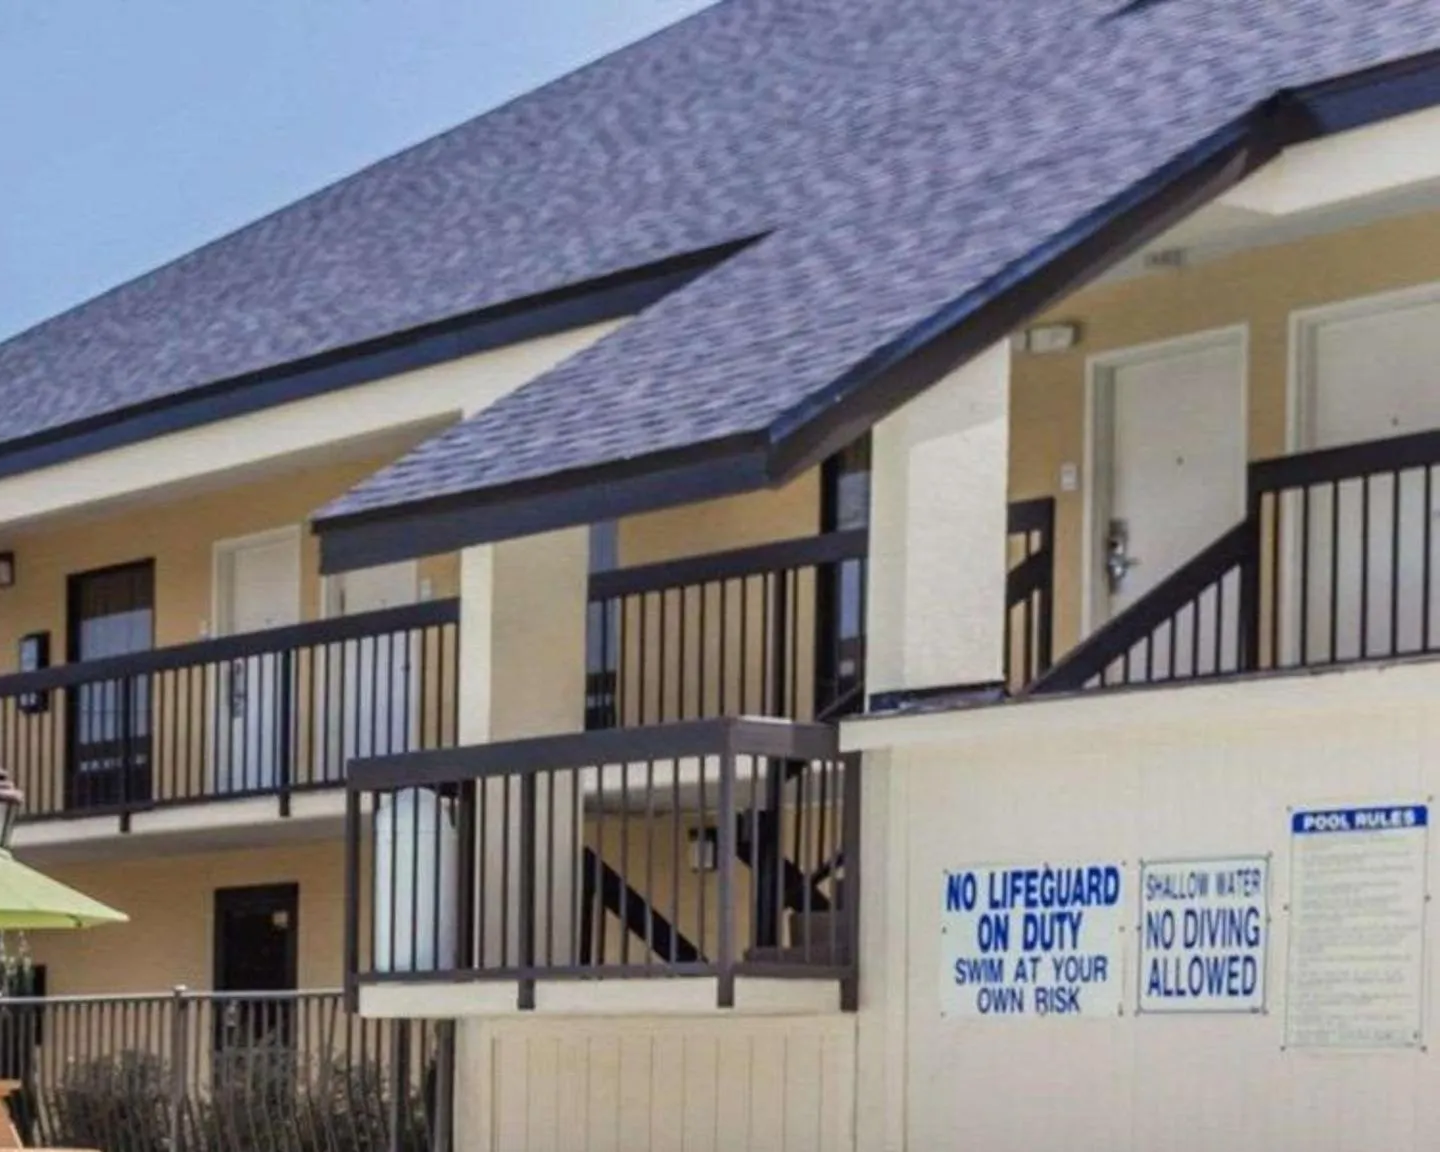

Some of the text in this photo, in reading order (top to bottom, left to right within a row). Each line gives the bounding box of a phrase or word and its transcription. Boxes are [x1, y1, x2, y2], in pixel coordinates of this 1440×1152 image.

[1303, 810, 1416, 831] POOL RULES
[946, 866, 1120, 911] NO LIFEGUARD
[1146, 868, 1260, 900] SHALLOW WATER
[978, 912, 1082, 952] ON DUTY
[1146, 906, 1260, 950] NO DIVING
[954, 957, 1108, 985] SWIM AT YOUR
[1147, 955, 1257, 997] ALLOWED
[977, 986, 1081, 1013] OWN RISK
